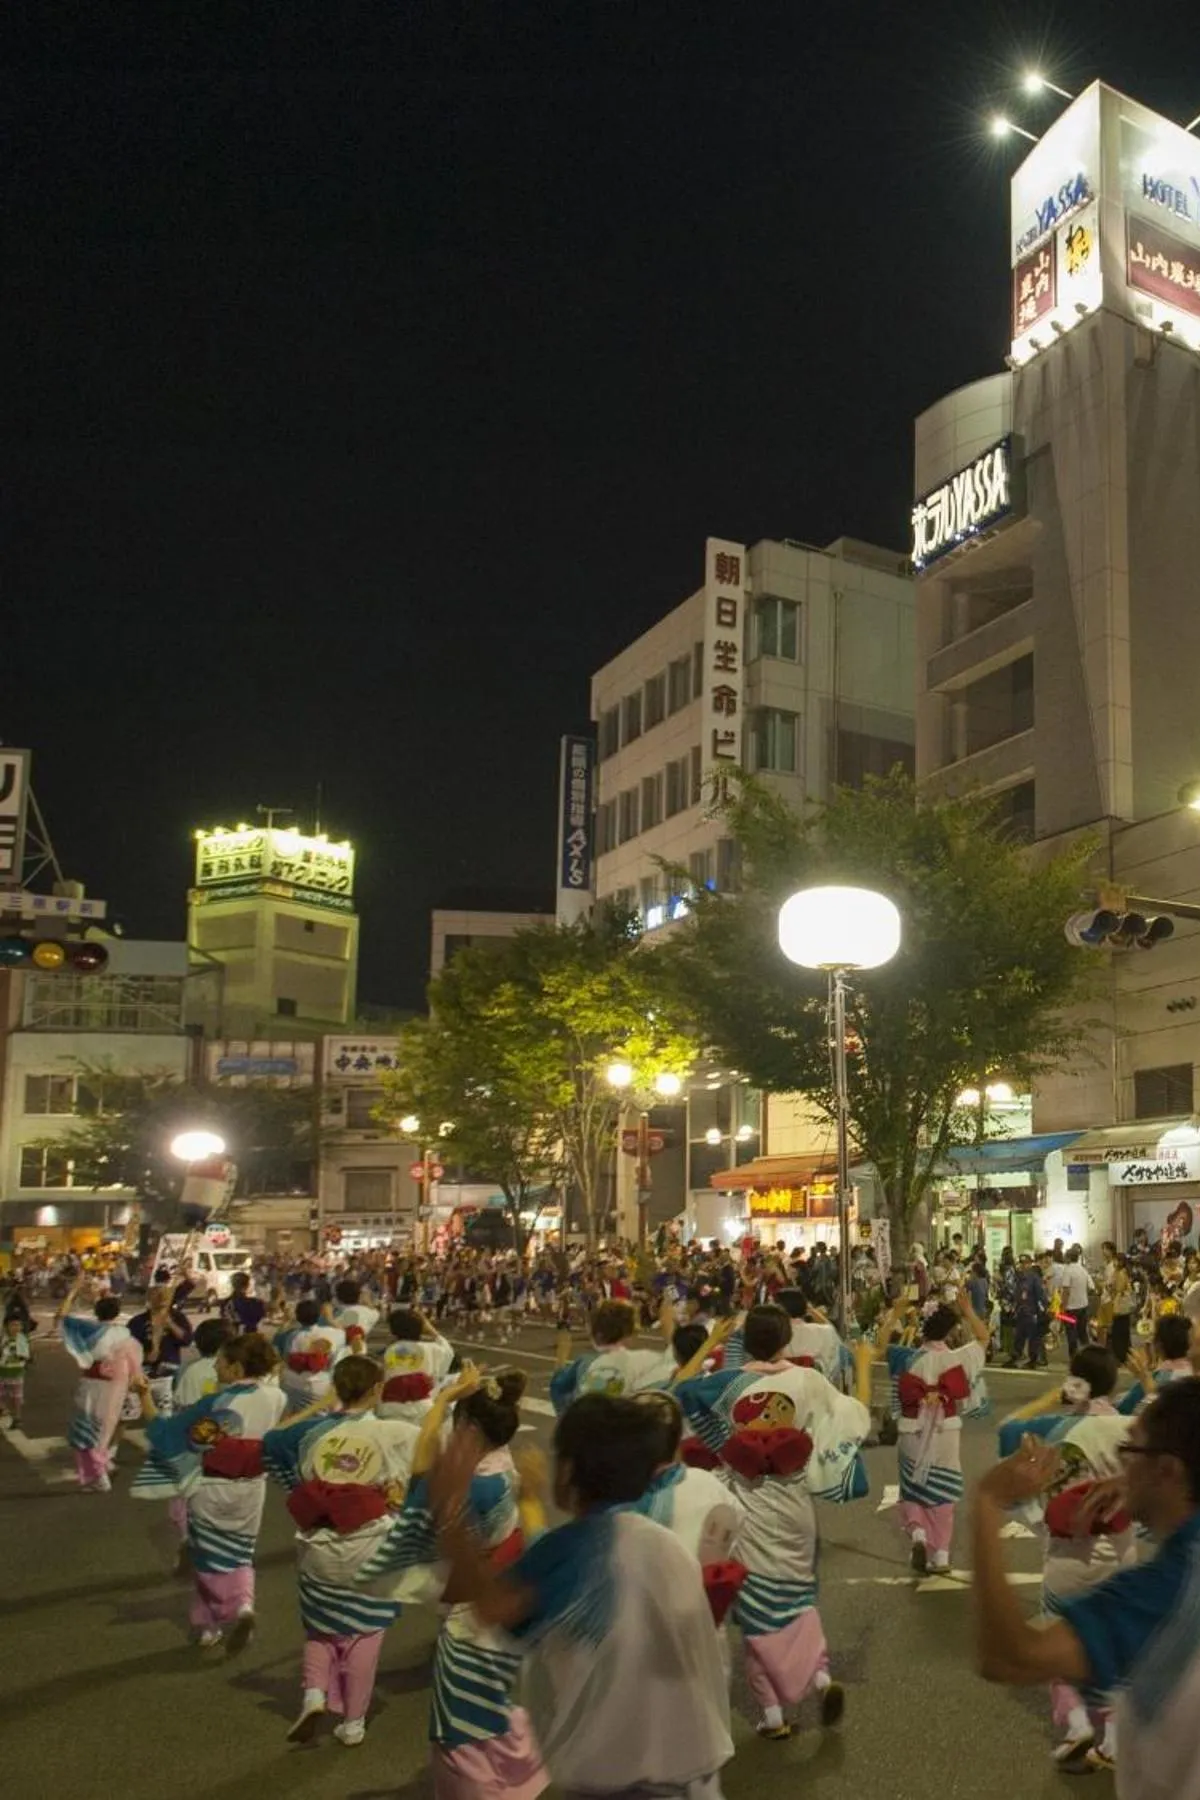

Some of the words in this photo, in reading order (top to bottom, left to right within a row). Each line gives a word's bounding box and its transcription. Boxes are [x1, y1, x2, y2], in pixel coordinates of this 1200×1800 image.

[1035, 171, 1090, 237] YASSA
[1143, 173, 1192, 221] HOTEL
[711, 551, 741, 802] 朝日生命ビル
